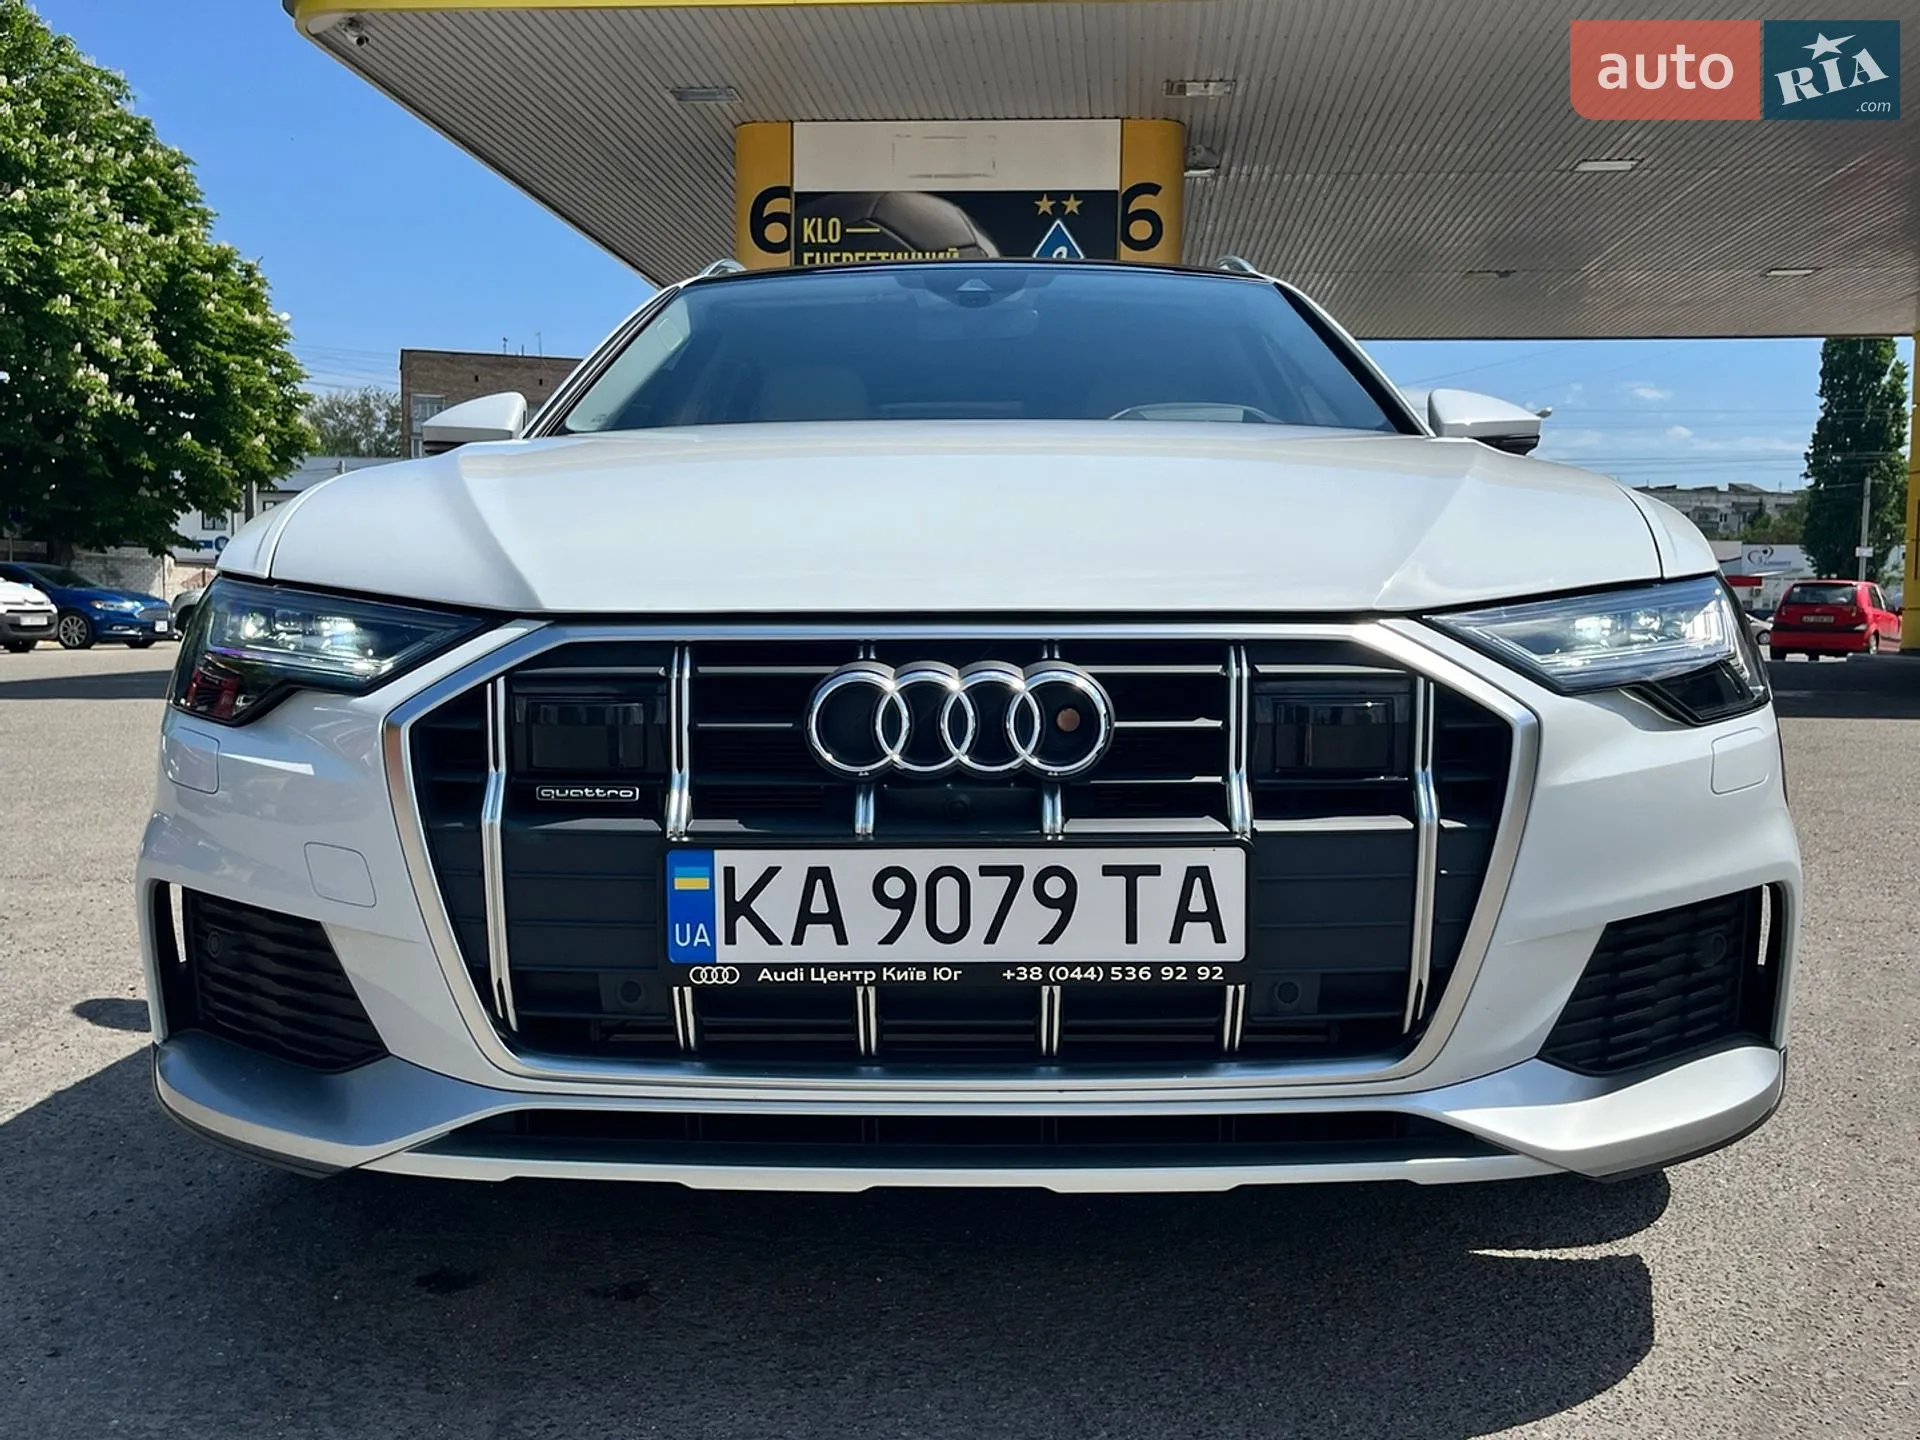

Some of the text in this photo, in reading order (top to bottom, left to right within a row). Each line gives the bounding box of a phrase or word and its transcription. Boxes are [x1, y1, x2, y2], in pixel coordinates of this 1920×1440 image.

[748, 186, 791, 254] 6
[1120, 182, 1164, 252] 6
[540, 787, 634, 799] quattro
[722, 864, 1228, 946] KA 9079 TA
[674, 923, 711, 947] UA
[757, 967, 963, 985] Audi Центр Київ Юг
[1002, 966, 1225, 982] +38 (044) 536 92 92
